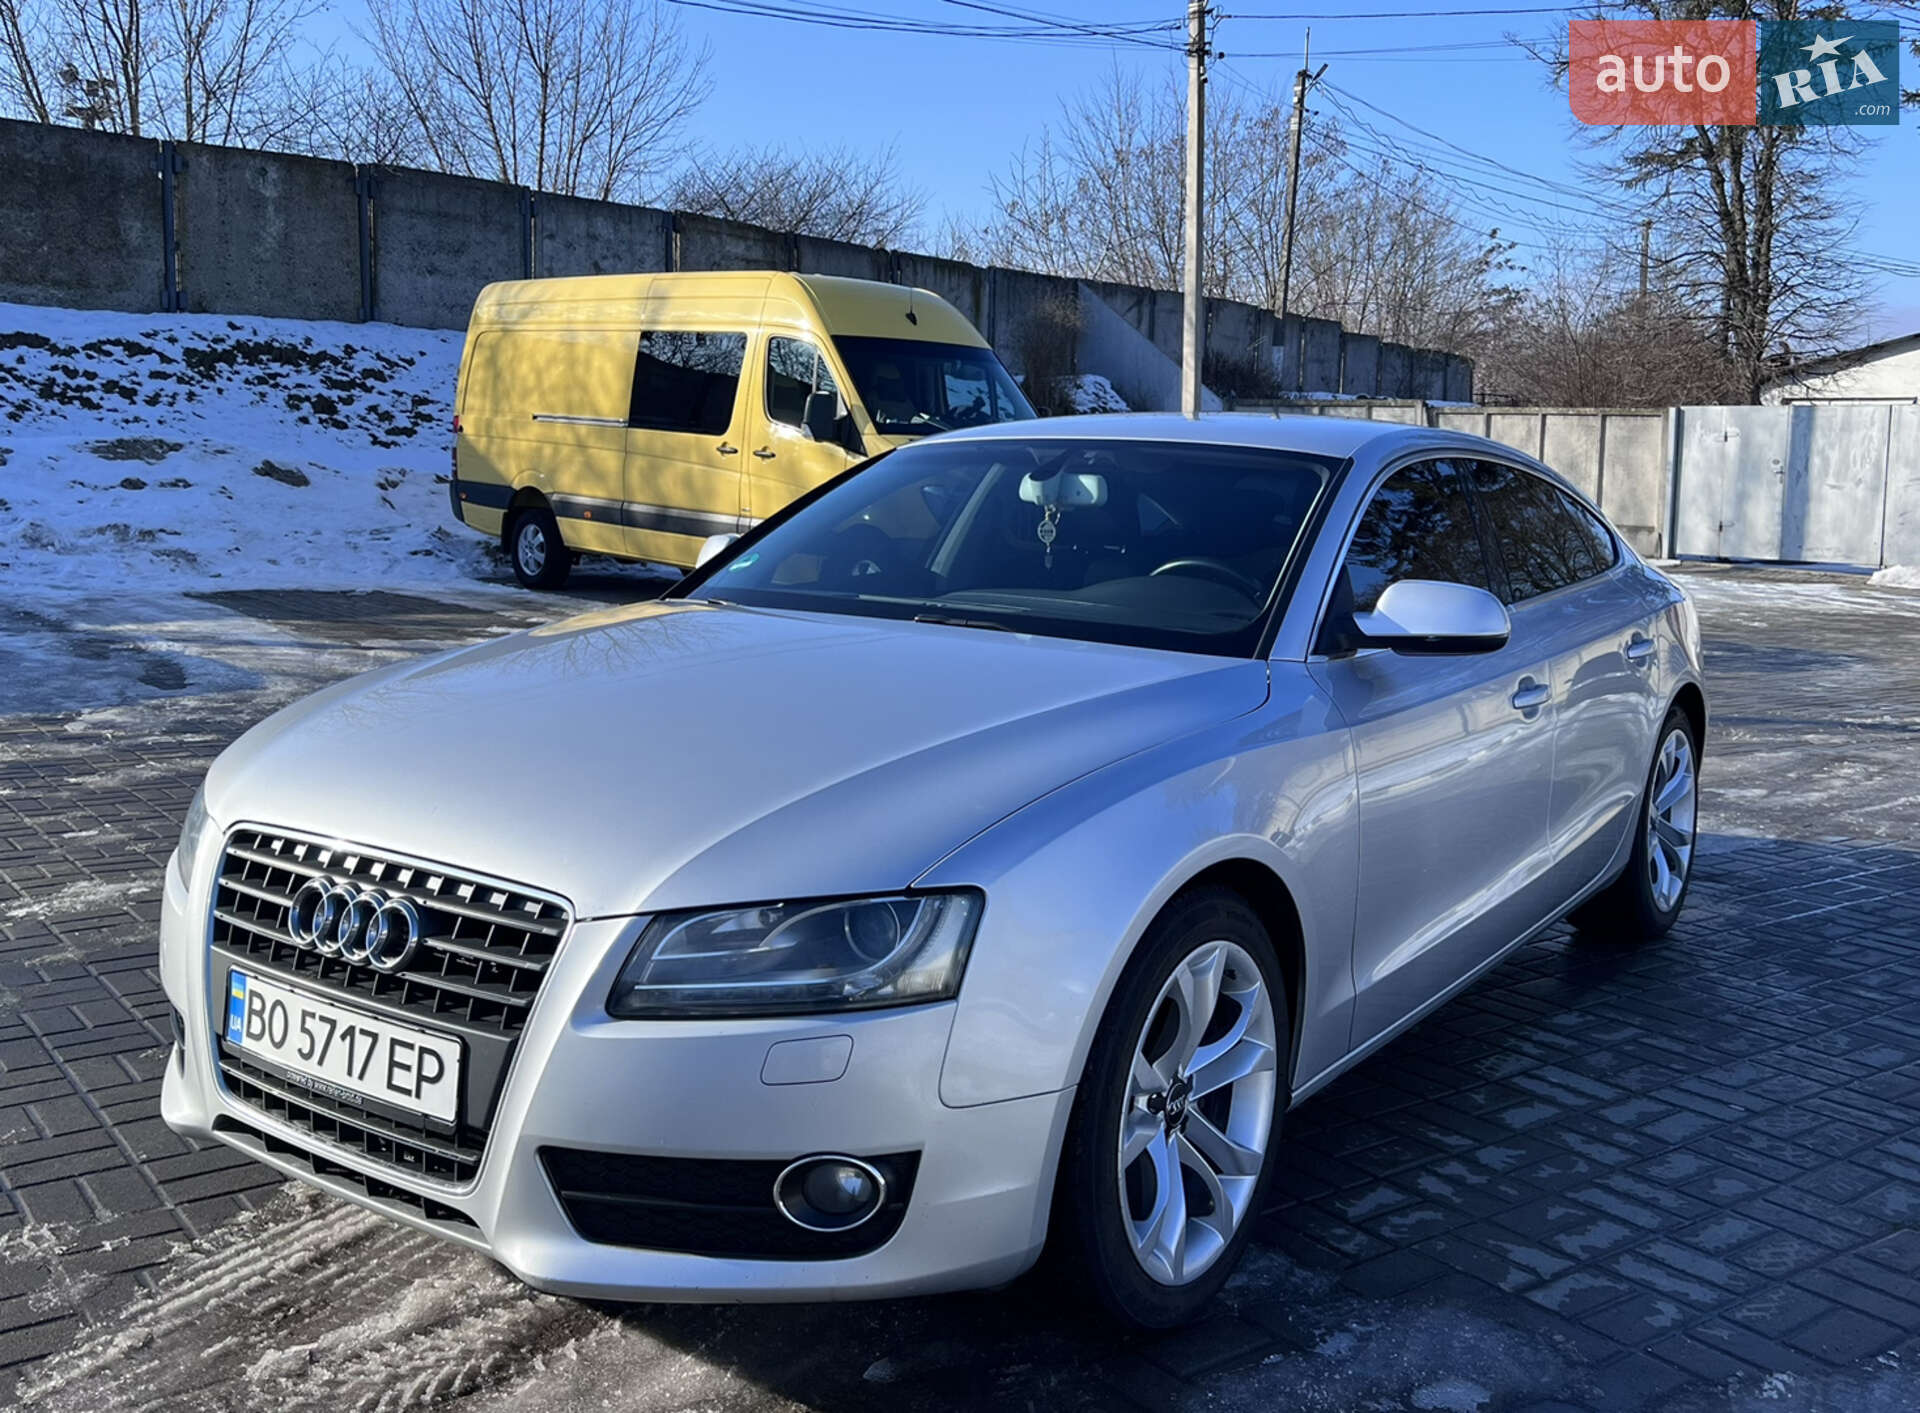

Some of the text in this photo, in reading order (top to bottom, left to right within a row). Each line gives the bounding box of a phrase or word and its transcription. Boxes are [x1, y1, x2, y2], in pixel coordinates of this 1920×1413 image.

[229, 1013, 242, 1033] UA
[246, 988, 289, 1050] BO
[297, 1008, 380, 1082] 5717
[386, 1036, 445, 1100] EP
